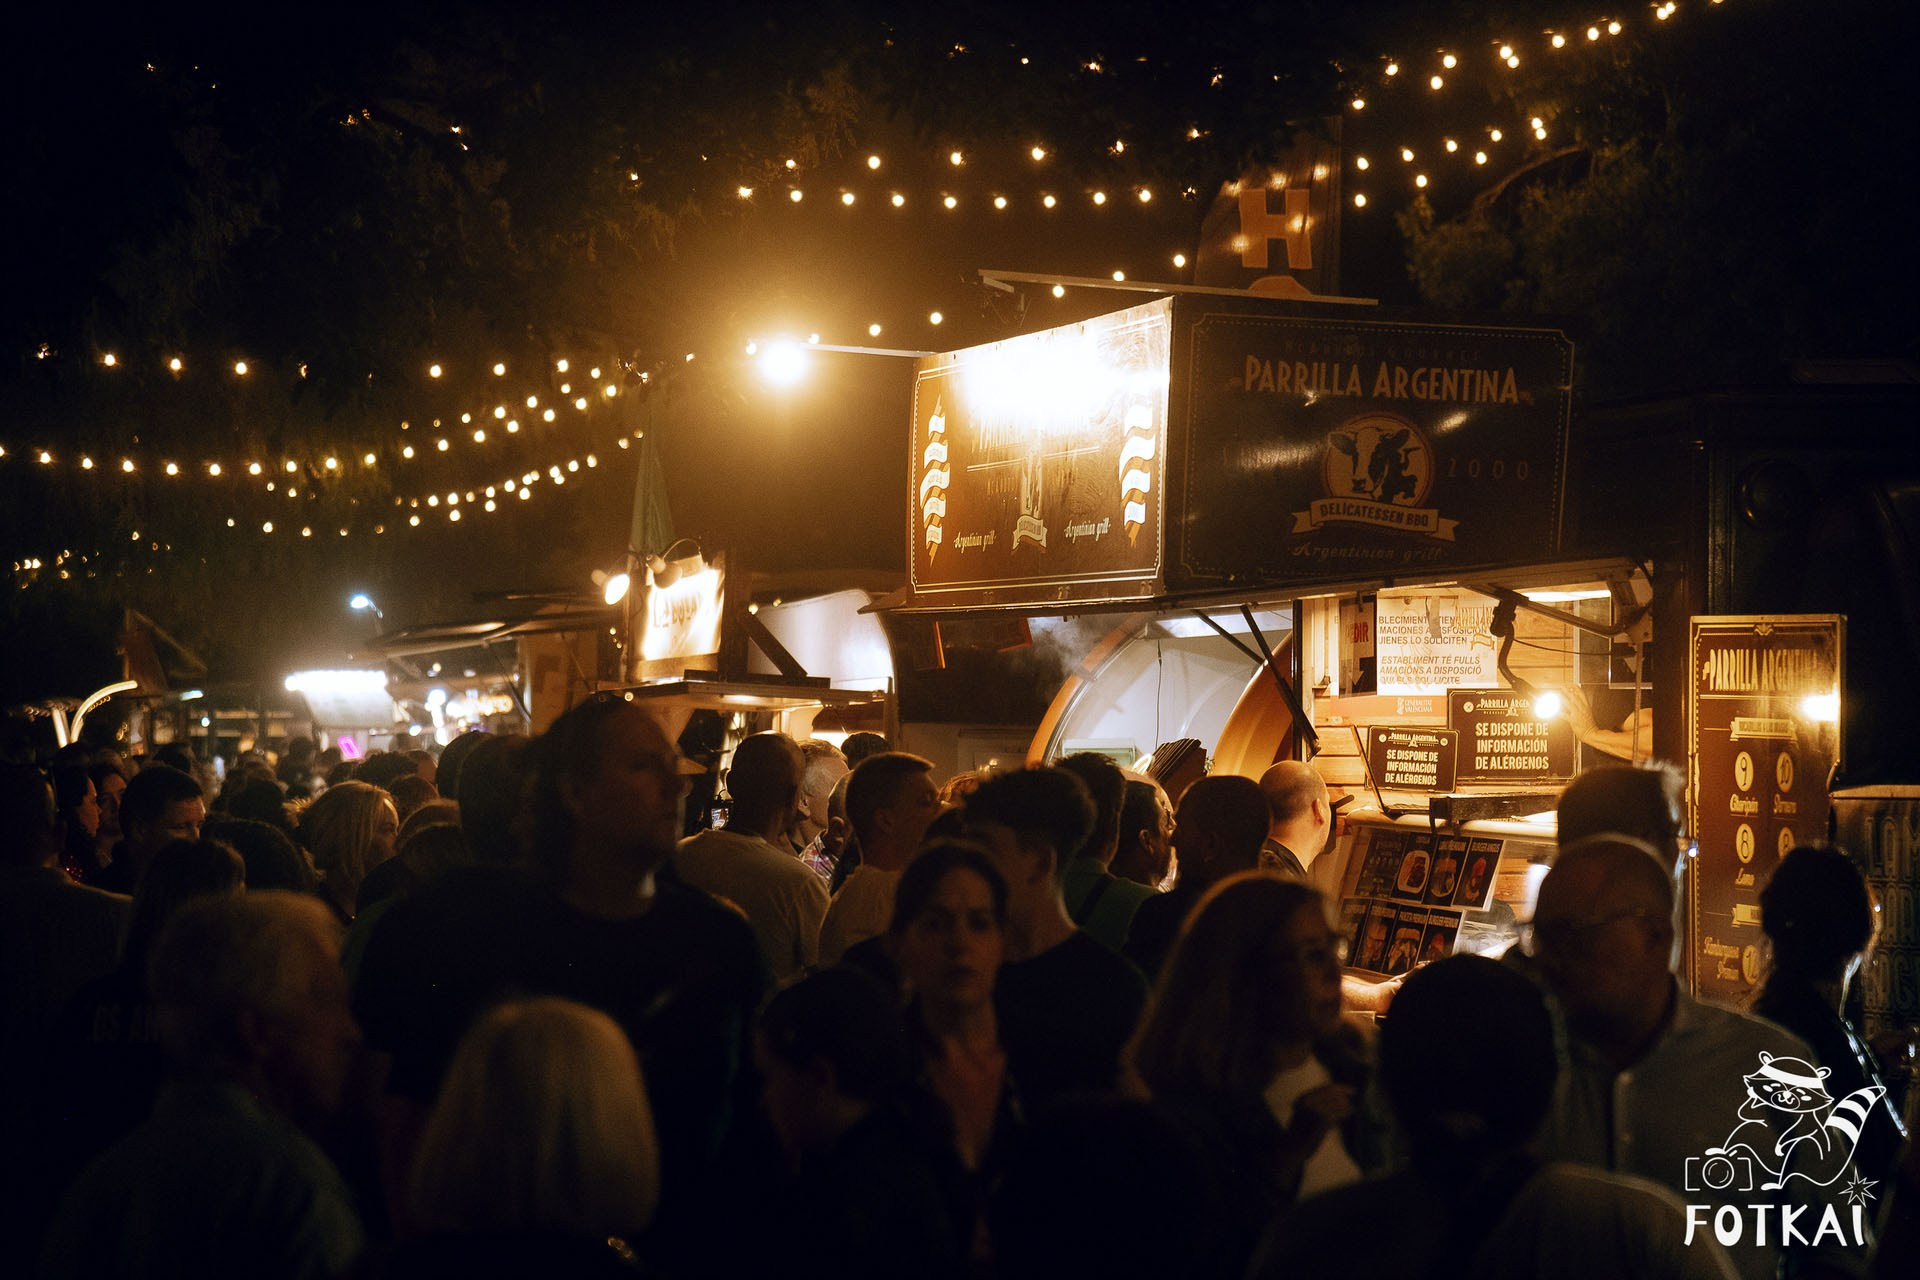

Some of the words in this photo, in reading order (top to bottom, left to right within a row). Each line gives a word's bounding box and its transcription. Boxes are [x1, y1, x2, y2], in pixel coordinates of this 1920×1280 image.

[1244, 354, 1363, 397] PARRILLA
[1372, 360, 1520, 405] ARGENTINA
[1320, 502, 1403, 524] DELICATESSEN
[1379, 616, 1429, 624] BLECIMIENT
[1410, 636, 1422, 645] LO
[1424, 636, 1468, 645] SOLICITEN
[1454, 655, 1481, 665] FULLS
[1709, 648, 1759, 691] PARRILLA
[1480, 699, 1509, 709] PARRILLA
[1475, 722, 1489, 737] SE
[1490, 722, 1534, 737] DISPONE
[1536, 722, 1549, 736] DE
[1477, 738, 1548, 753] INFORMACIÓN
[1386, 749, 1396, 760] SE
[1397, 749, 1427, 762] DISPONE
[1428, 752, 1439, 762] DE
[1386, 761, 1437, 774] INFORMACIÓN
[1475, 756, 1489, 770] DE
[1490, 755, 1550, 770] ALÉRGENOS
[1385, 773, 1395, 783] DE
[1395, 773, 1437, 786] ALÉRGENOS
